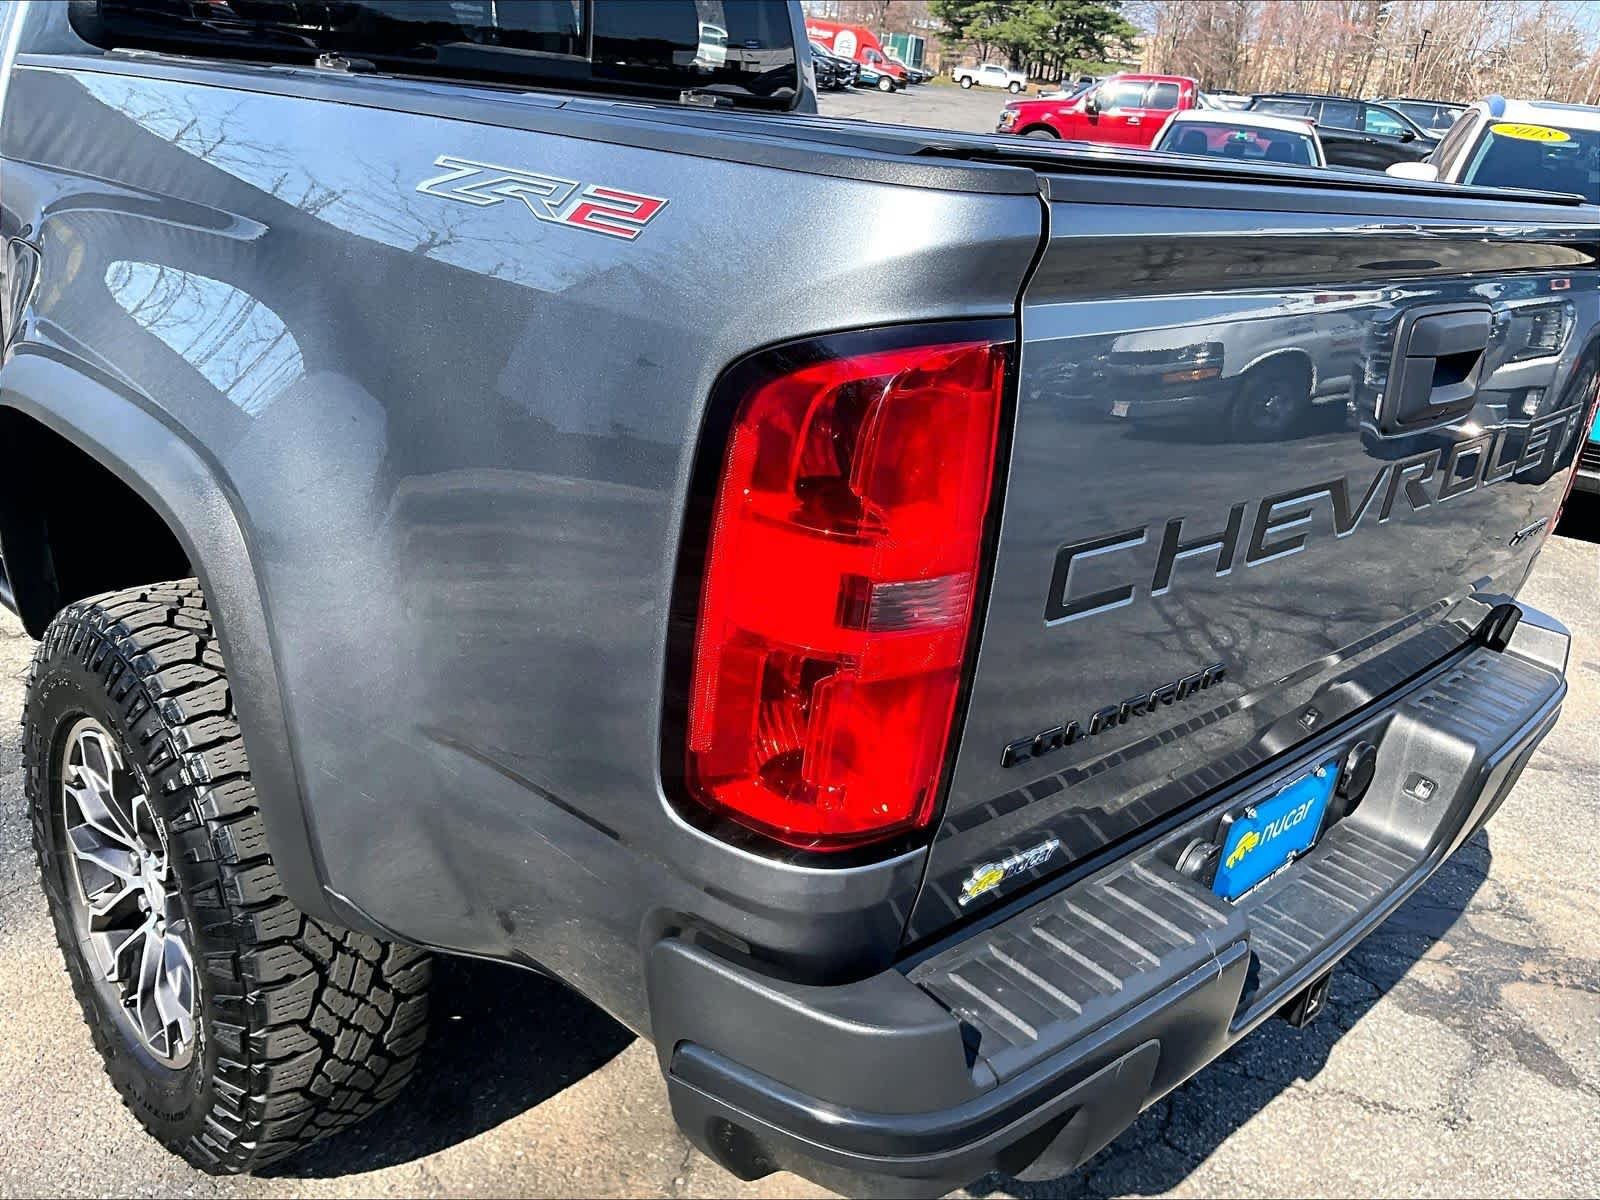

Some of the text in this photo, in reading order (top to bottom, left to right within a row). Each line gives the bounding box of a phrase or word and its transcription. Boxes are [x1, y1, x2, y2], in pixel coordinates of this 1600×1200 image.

[416, 154, 671, 243] ZR2
[1043, 402, 1584, 628] CHEVROLET
[1000, 663, 1225, 768] COLORADO
[1260, 798, 1315, 846] nucar
